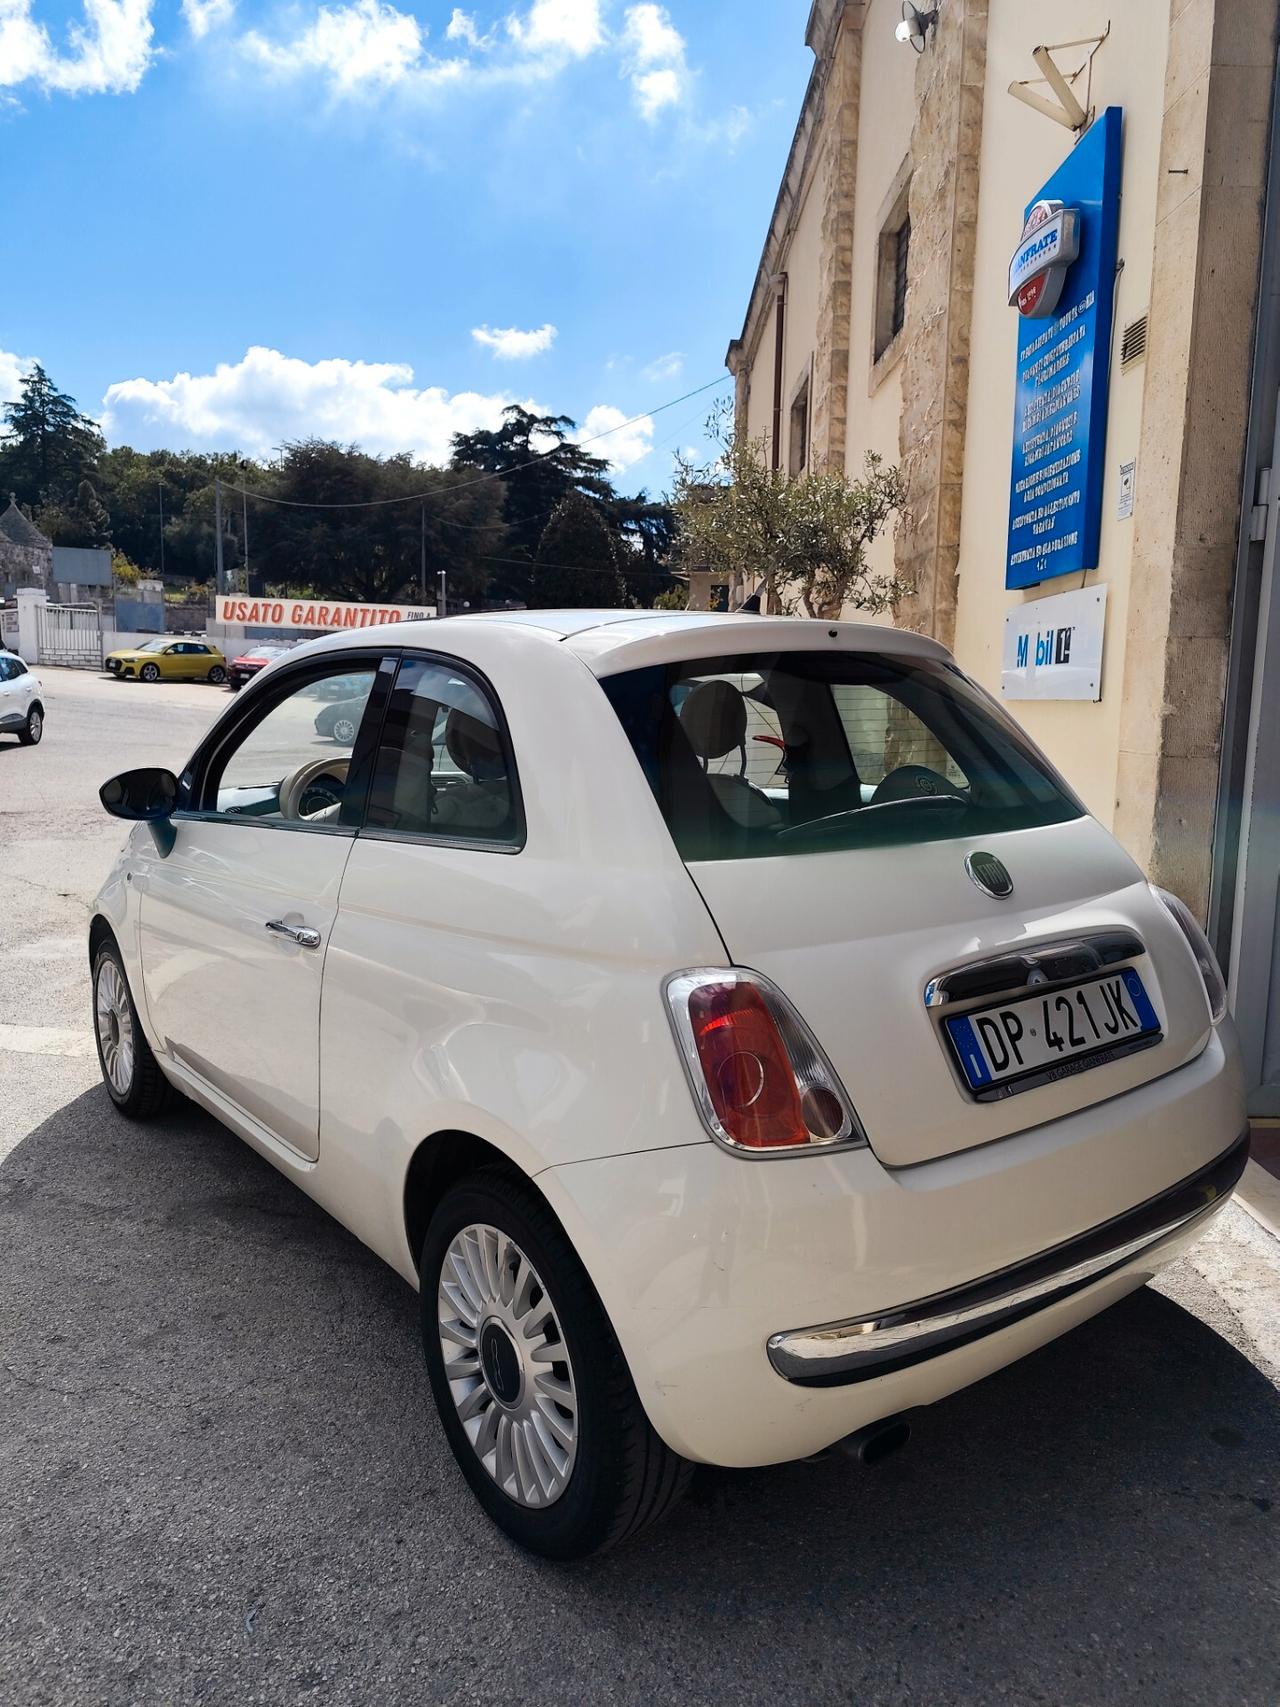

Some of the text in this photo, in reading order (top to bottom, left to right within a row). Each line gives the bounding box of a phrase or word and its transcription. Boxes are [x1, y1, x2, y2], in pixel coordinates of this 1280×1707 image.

[223, 601, 285, 624] USATO
[291, 604, 402, 628] GARANTITO
[407, 611, 424, 619] FINO
[1017, 630, 1054, 668] Mbil
[976, 1010, 1024, 1072] DP
[970, 1054, 982, 1078] I
[1056, 1062, 1083, 1076] GARAGE
